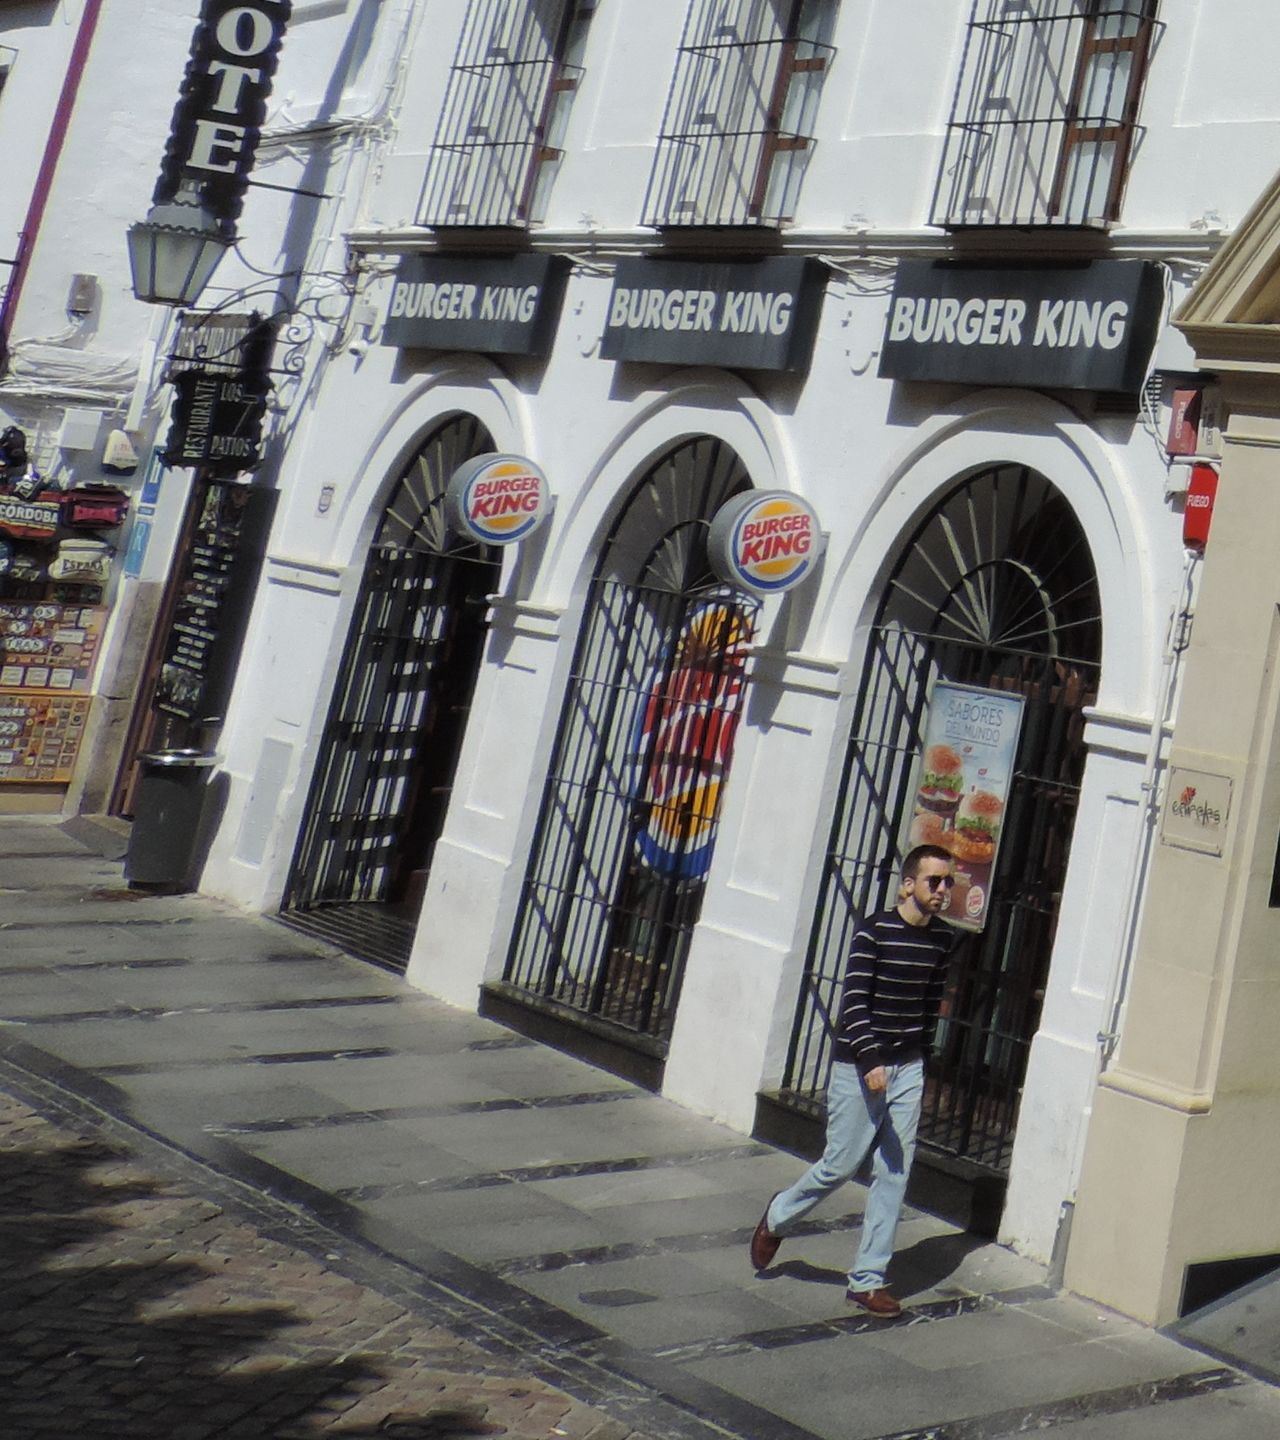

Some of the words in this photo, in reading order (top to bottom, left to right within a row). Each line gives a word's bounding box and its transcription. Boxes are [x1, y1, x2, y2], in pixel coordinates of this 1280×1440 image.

[390, 282, 476, 320] BURGER
[479, 285, 538, 323] KING
[609, 288, 716, 332] BURGER
[720, 291, 793, 336] KING
[889, 297, 1027, 346] BURGER
[1032, 300, 1129, 350] KING
[220, 382, 243, 403] LOS
[183, 380, 217, 459] RESTAURANTE
[210, 435, 251, 457] PATIOS
[473, 477, 541, 498] BURGER
[1187, 494, 1210, 508] FUEGO
[471, 492, 539, 520] KING
[742, 515, 810, 542] BURGER
[740, 531, 811, 566] KING
[946, 700, 1004, 727] SABORES
[964, 724, 1001, 743] MUNDO
